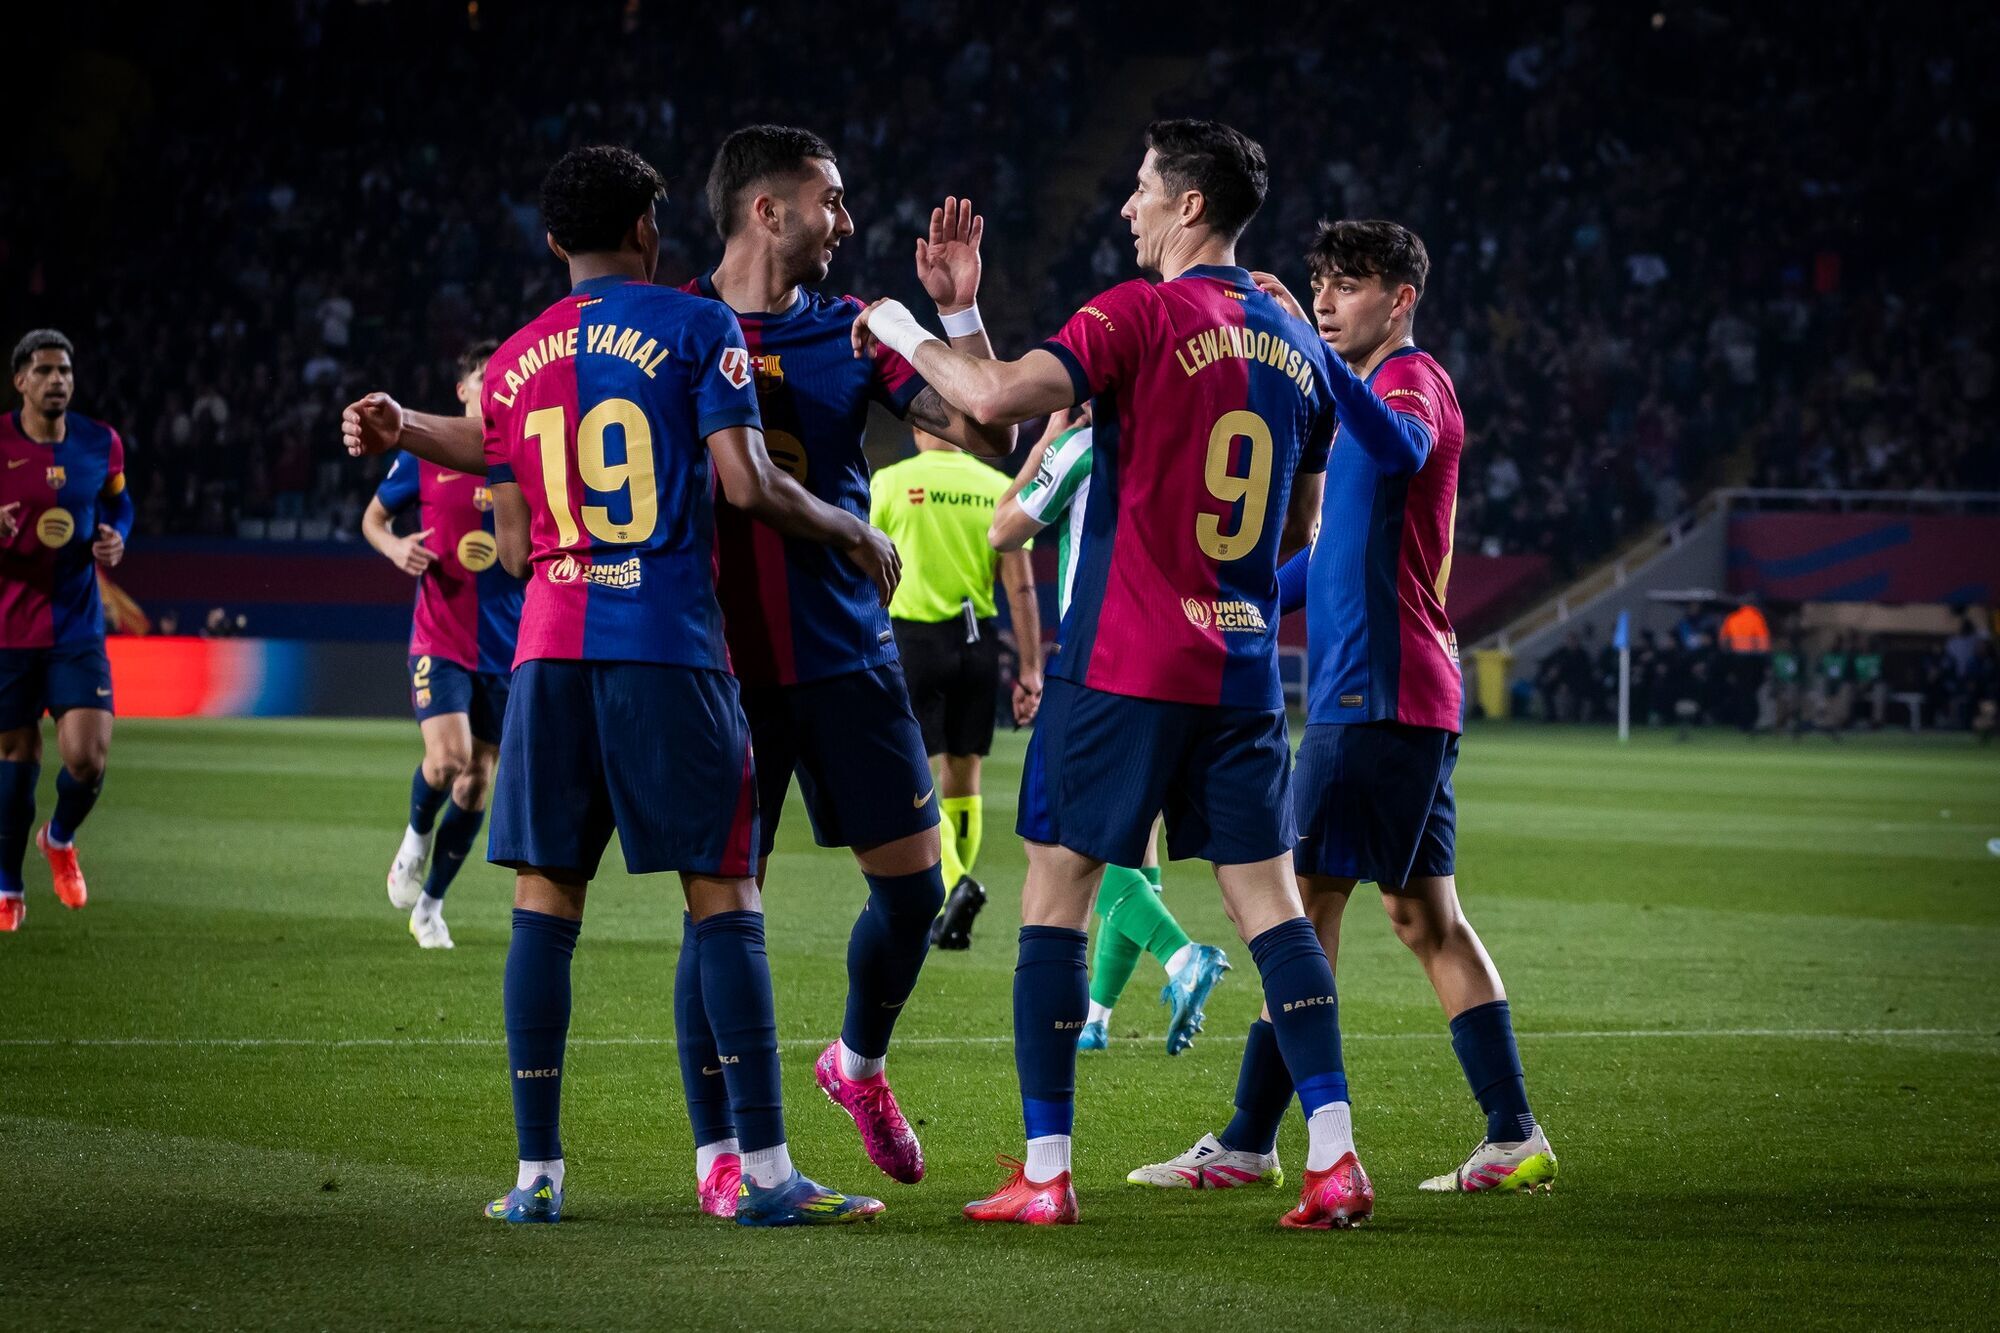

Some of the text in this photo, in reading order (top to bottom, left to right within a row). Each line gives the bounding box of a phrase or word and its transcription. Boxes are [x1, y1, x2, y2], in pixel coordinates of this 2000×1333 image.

[493, 324, 670, 408] LAMINE YAMAL
[1175, 325, 1315, 397] LEWANDOWSKI
[524, 397, 657, 547] 19
[1196, 410, 1273, 561] 9
[584, 557, 641, 576] UNHCR
[1212, 601, 1262, 618] UNHCR
[1215, 613, 1267, 629] ACNUR
[413, 655, 431, 688] 2
